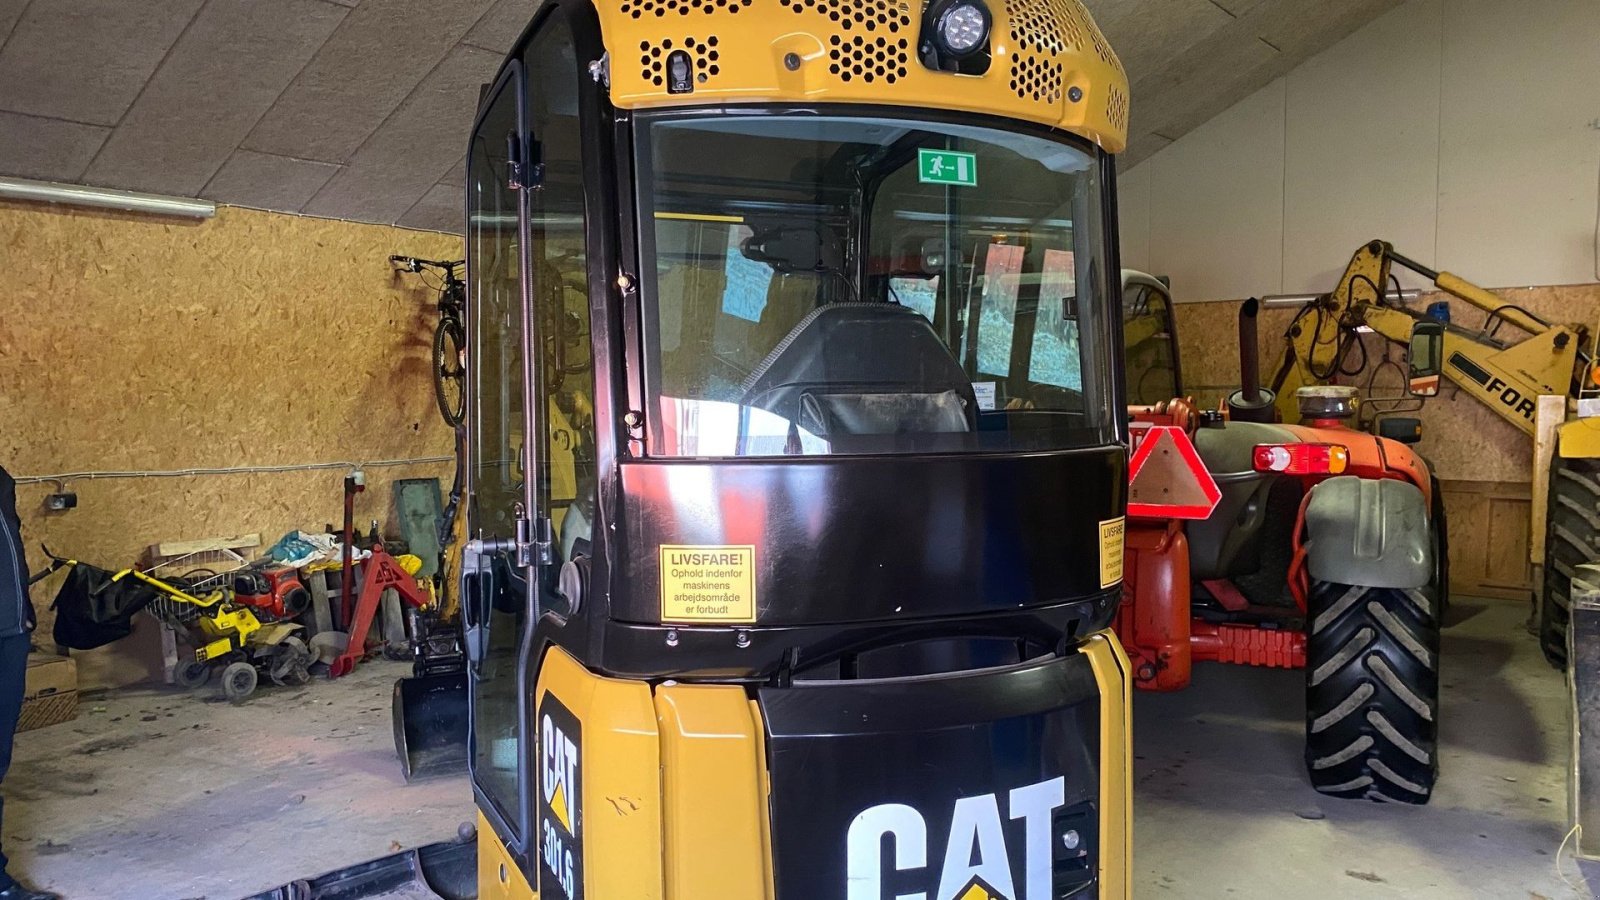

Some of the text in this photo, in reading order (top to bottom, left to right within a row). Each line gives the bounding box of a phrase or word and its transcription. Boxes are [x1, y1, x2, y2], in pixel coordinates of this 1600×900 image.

[1486, 378, 1536, 424] FOR
[671, 553, 743, 566] LIVSFARE!
[671, 569, 743, 579] Ophold indenfor
[683, 582, 730, 590] maskinens
[673, 593, 741, 603] arbejdsområde
[696, 605, 729, 614] forbudt
[542, 713, 578, 838] CAT
[846, 775, 1065, 900] CAT
[543, 817, 574, 900] 301.6
